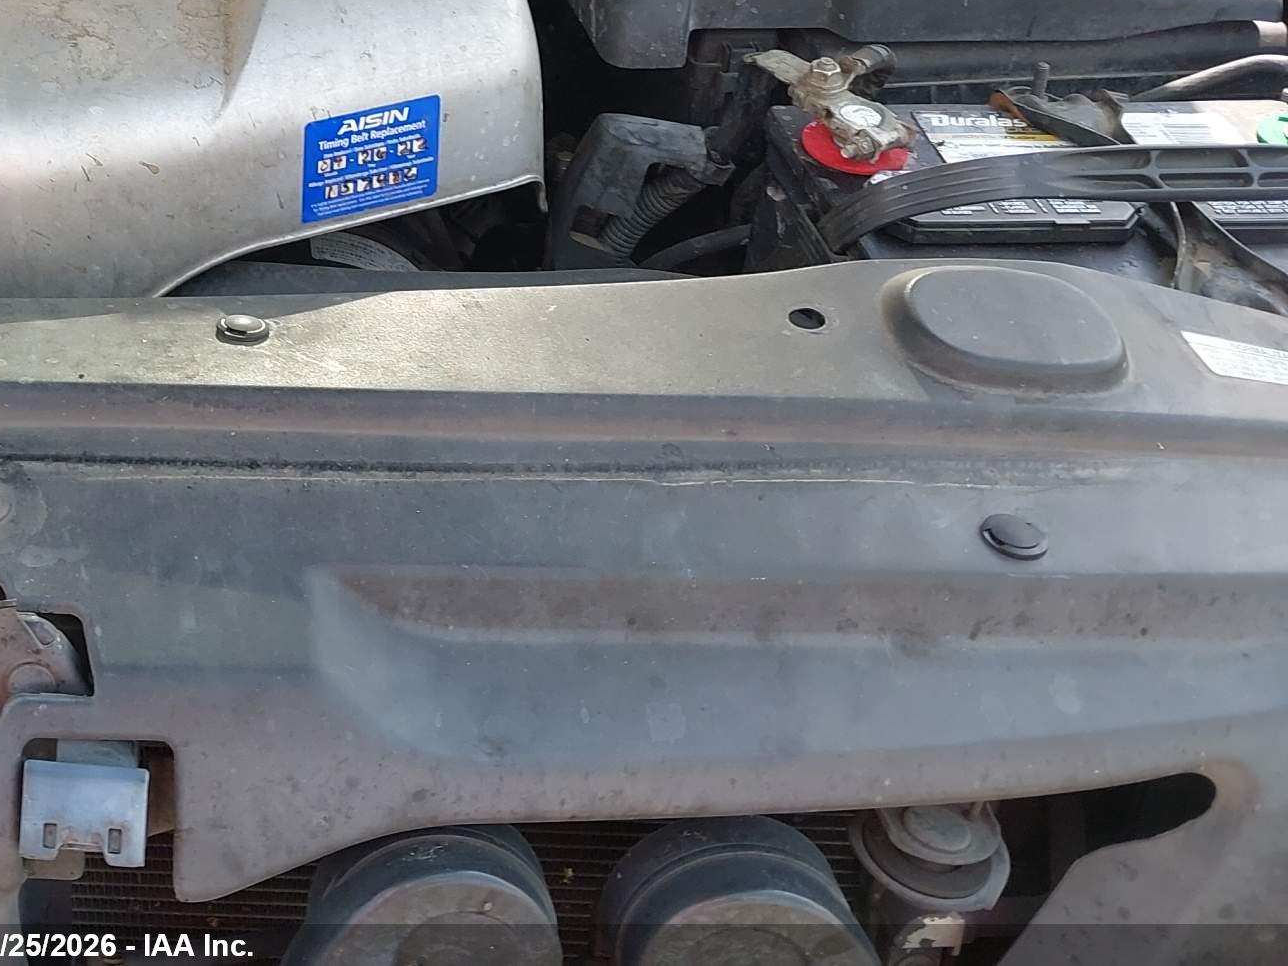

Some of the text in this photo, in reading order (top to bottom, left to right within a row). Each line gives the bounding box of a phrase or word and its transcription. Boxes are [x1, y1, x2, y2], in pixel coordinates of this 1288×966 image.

[337, 107, 409, 135] AISIN
[923, 113, 1029, 127] Duralas
[318, 139, 349, 151] Timing
[350, 132, 368, 144] Belt
[370, 120, 426, 139] Replacement
